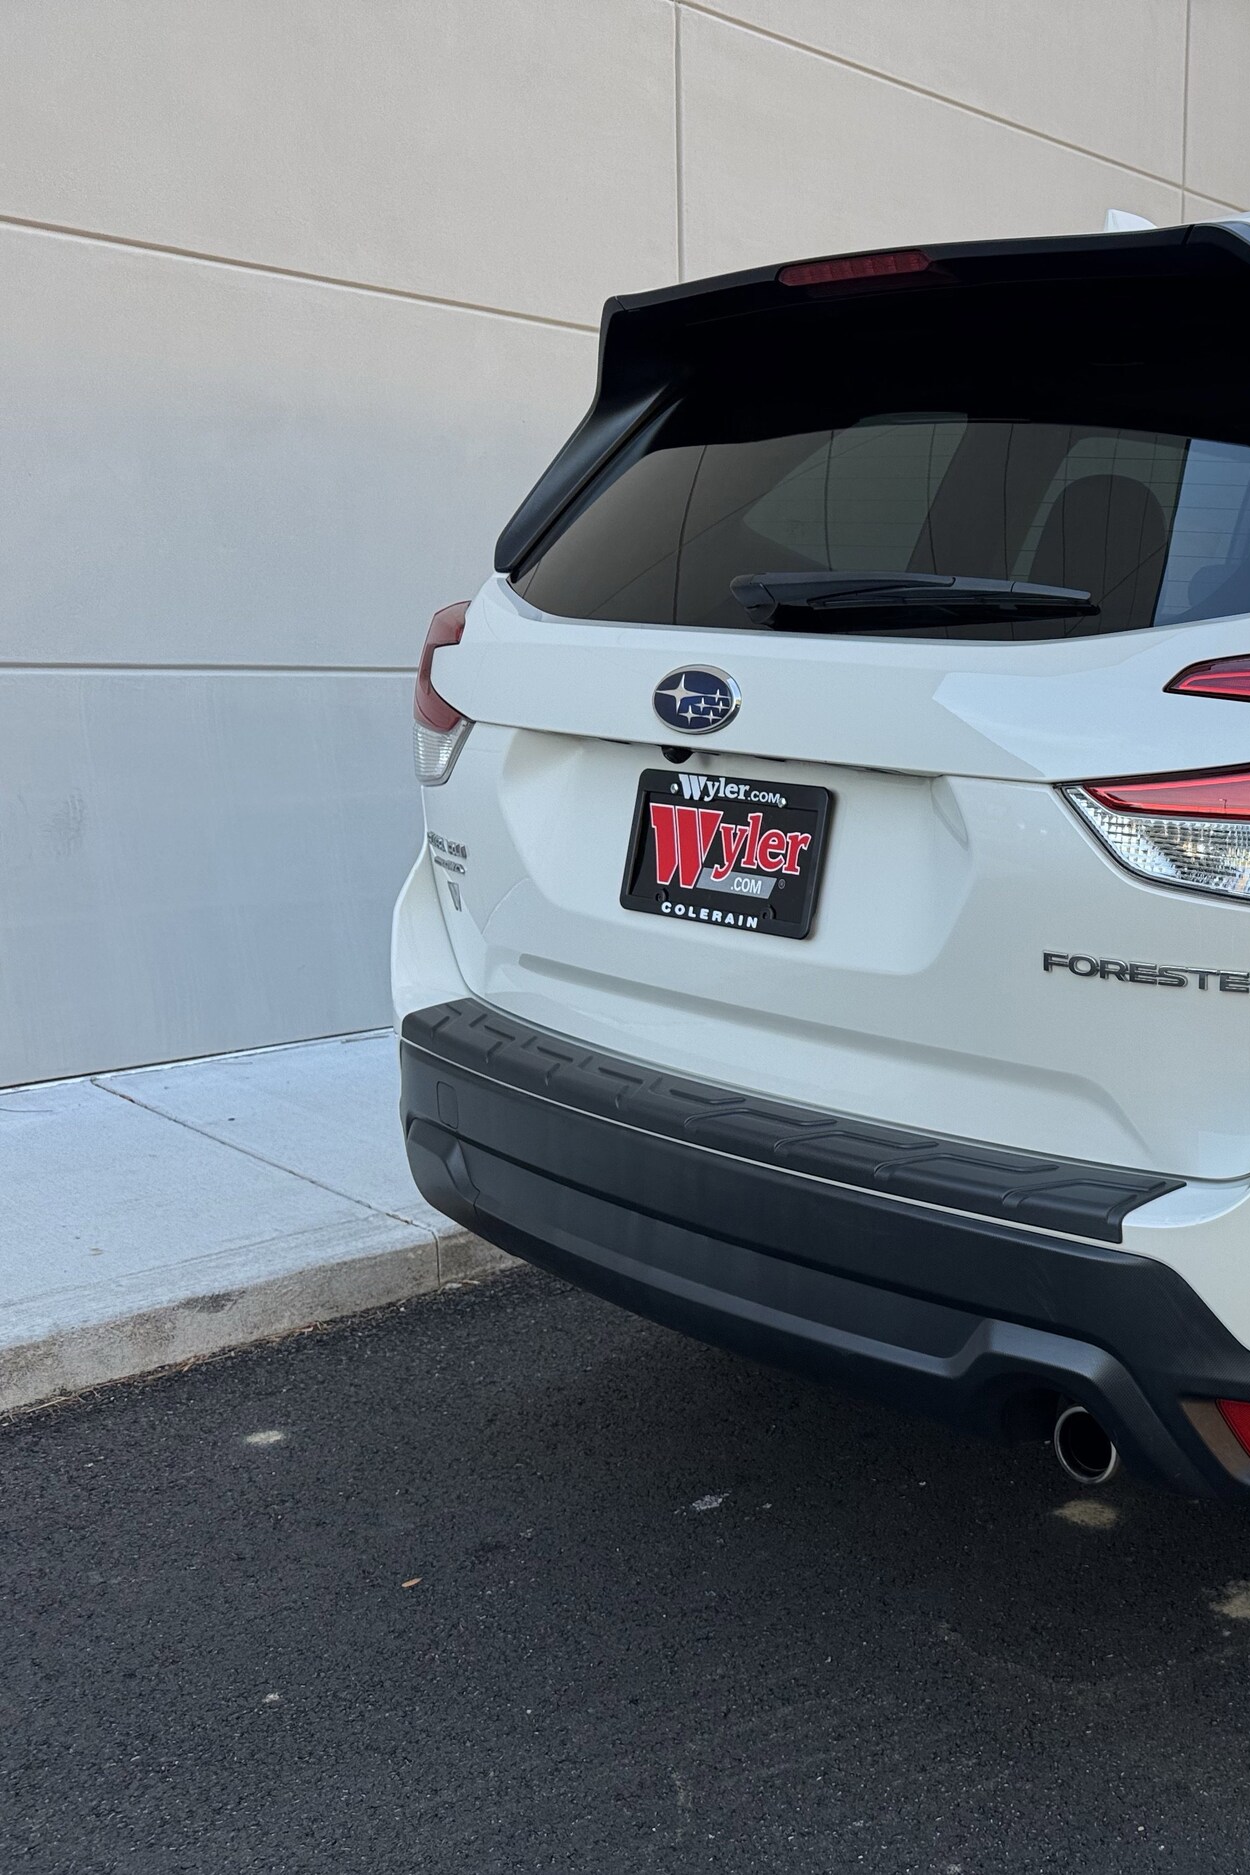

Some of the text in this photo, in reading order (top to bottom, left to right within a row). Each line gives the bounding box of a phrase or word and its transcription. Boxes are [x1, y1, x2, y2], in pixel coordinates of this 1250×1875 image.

[650, 804, 811, 889] Wyler
[730, 877, 762, 895] .COM
[661, 902, 758, 929] COLERAIN
